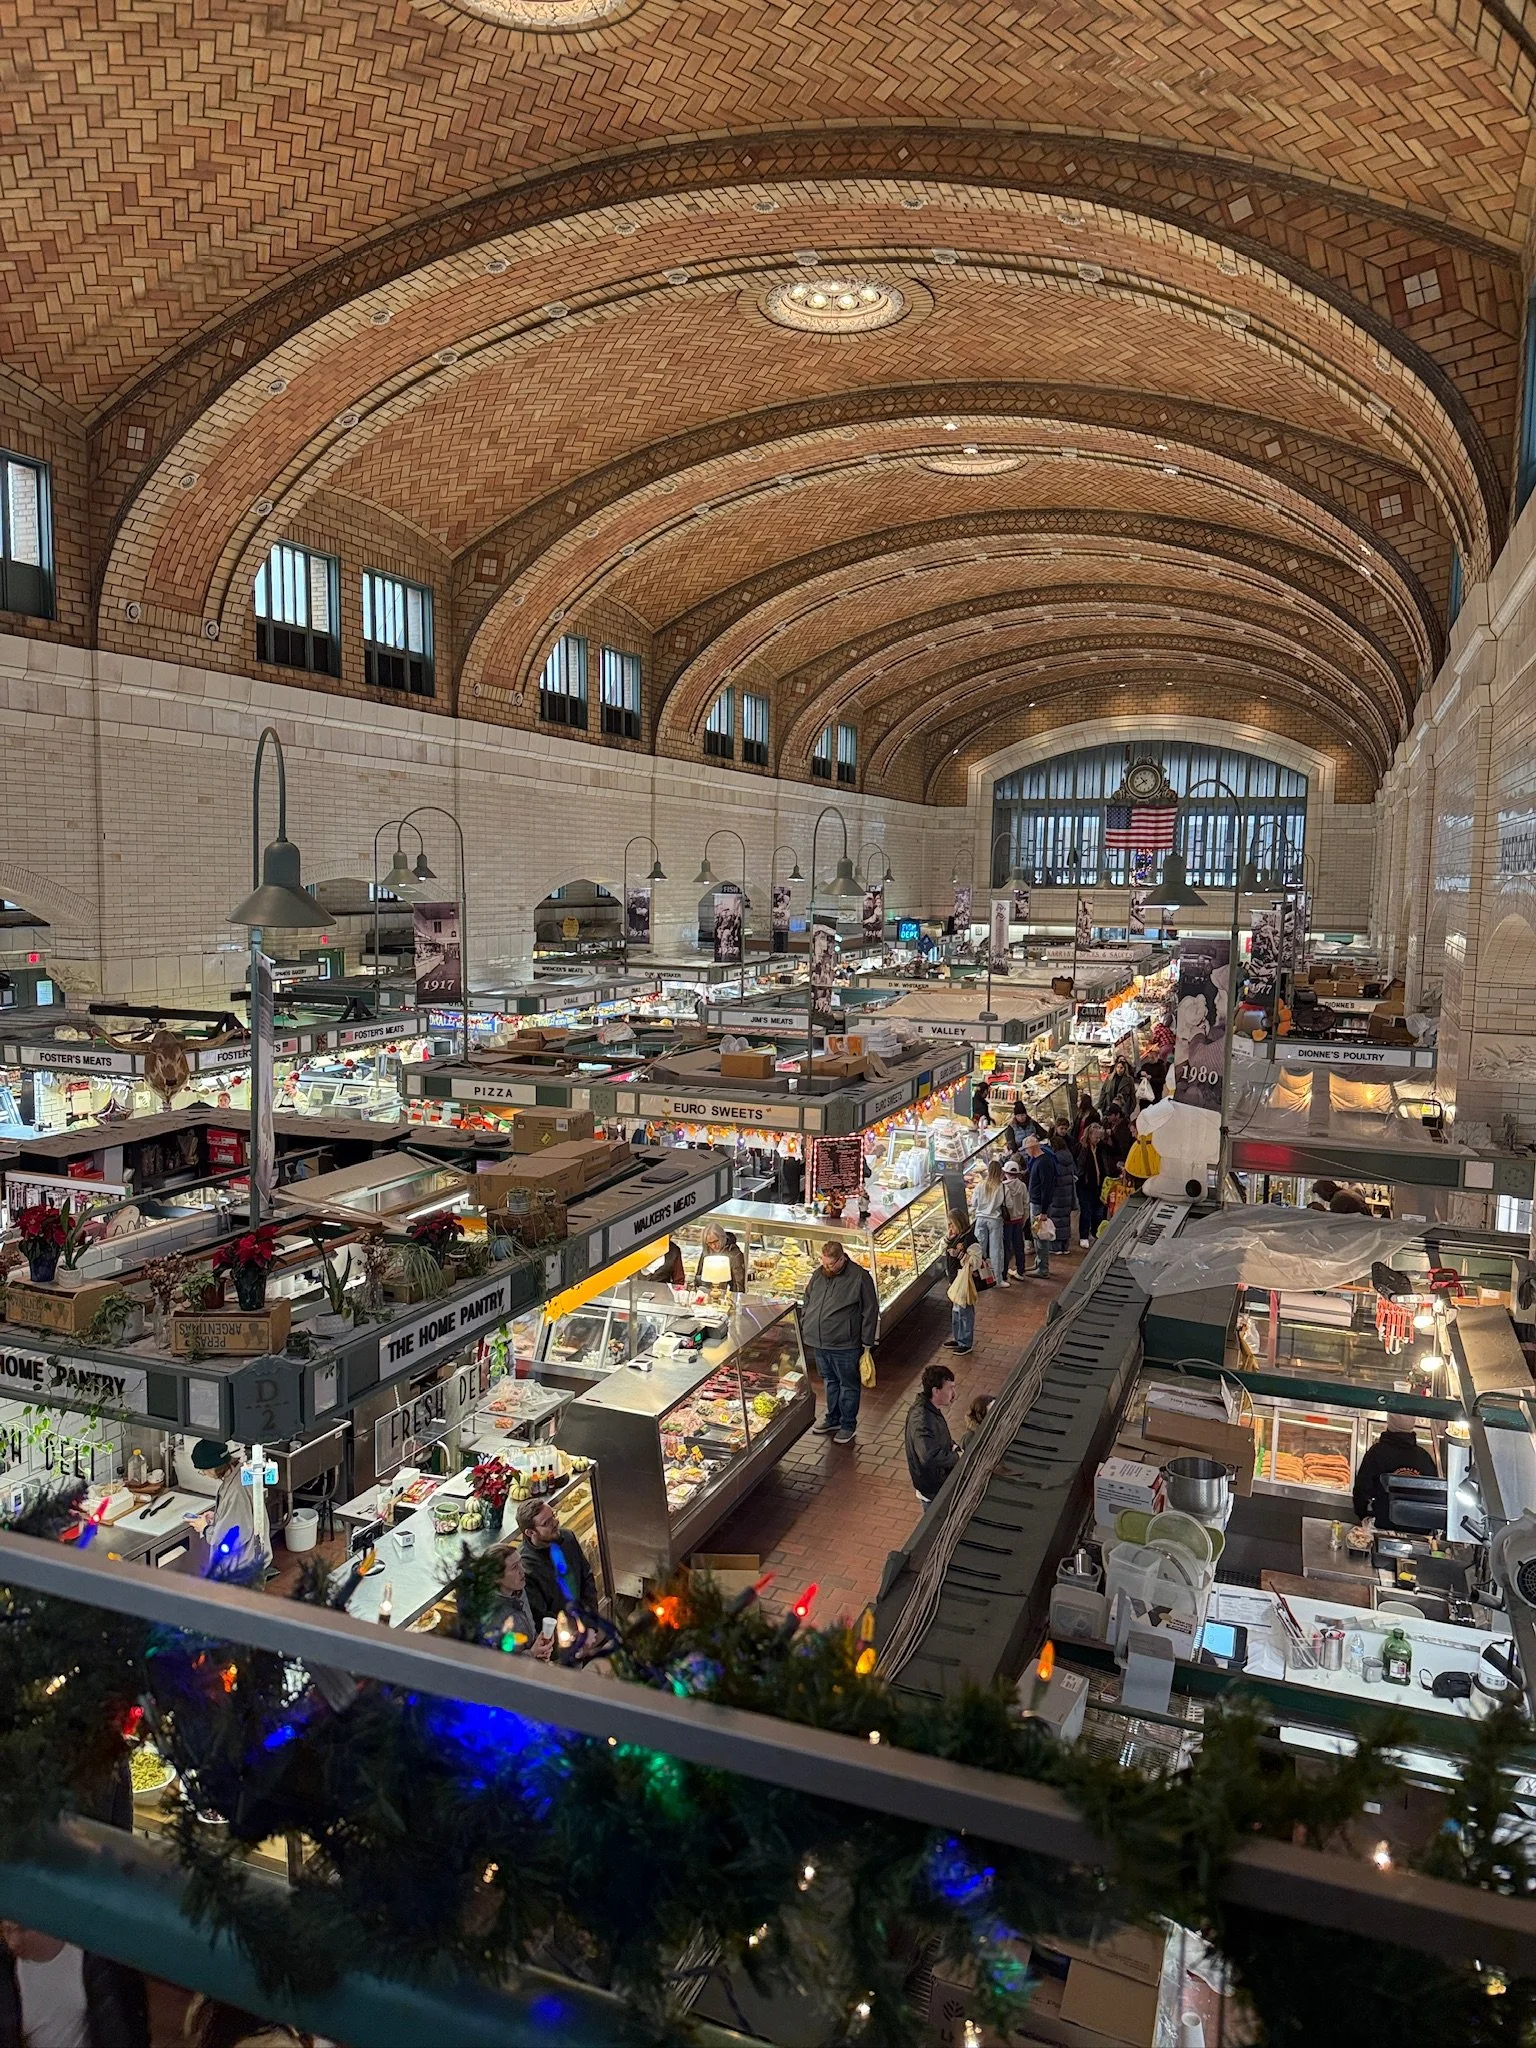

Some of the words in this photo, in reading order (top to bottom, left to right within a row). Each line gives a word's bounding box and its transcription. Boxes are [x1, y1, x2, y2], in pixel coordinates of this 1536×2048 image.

[423, 979, 455, 992] 1917
[751, 1016, 768, 1024] JIM'S
[771, 1017, 793, 1025] MEATS
[354, 1028, 384, 1040] FOSTER'S
[385, 1025, 404, 1035] MEATS
[931, 1026, 966, 1036] VALLEY
[39, 1053, 81, 1064] FOSTER'S
[83, 1056, 112, 1067] MEATS
[1298, 1050, 1340, 1059] DIONNE'S
[1344, 1051, 1384, 1062] POULTRY
[1181, 1065, 1219, 1085] 1980
[474, 1086, 513, 1098] PIZZA
[674, 1102, 706, 1115] EURO
[711, 1105, 764, 1120] SWEETS
[875, 1100, 887, 1113] EURO
[634, 1204, 671, 1235] WALKER'S
[673, 1191, 696, 1214] MEATS
[388, 1333, 415, 1363] THE
[419, 1312, 455, 1348] HOME
[460, 1287, 505, 1326] PANTRY
[195, 1335, 226, 1348] PERAS
[256, 1379, 278, 1403] D
[262, 1409, 276, 1431] 2
[391, 1385, 445, 1448] FRESH
